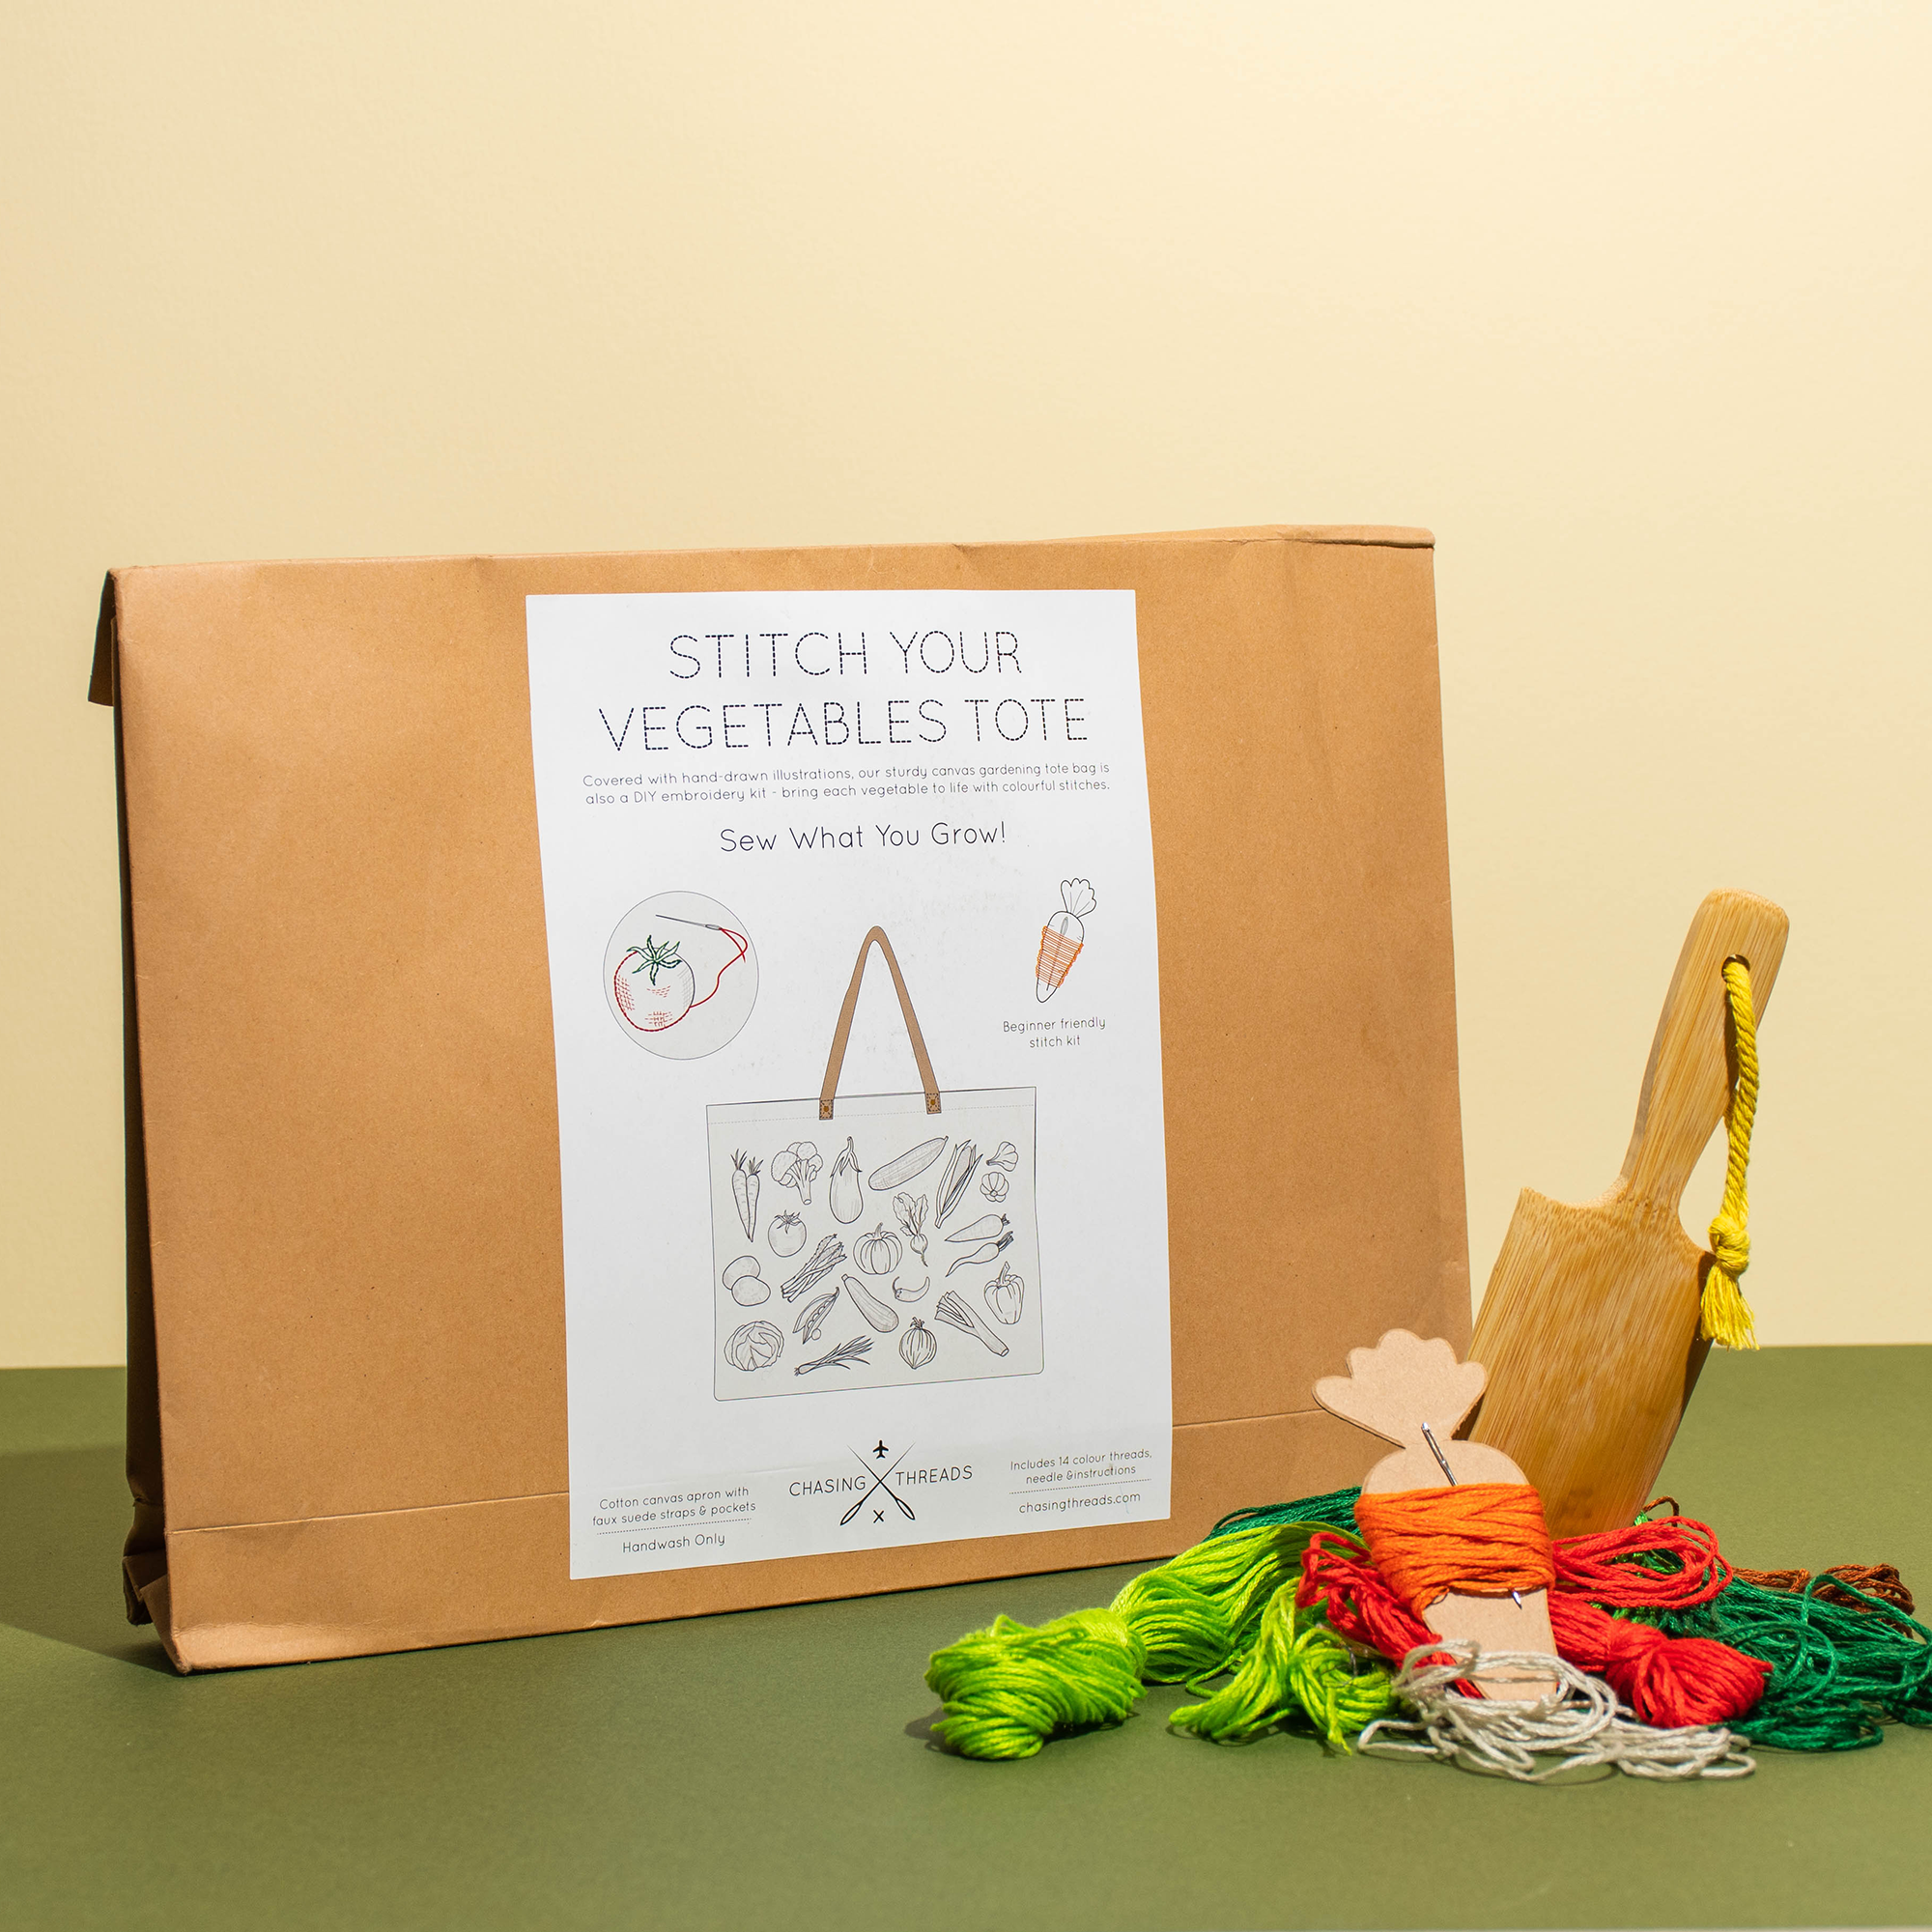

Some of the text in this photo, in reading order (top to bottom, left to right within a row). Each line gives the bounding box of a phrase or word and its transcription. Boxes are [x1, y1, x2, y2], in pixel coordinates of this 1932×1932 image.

[669, 630, 1023, 680] STITCH YOUR
[598, 697, 1088, 753] VEGETABLES TOTE
[582, 762, 1110, 787] Covered with hand-drawn illustrations, our sturdy canvas gardening tote bag is
[585, 792, 615, 805] also
[619, 794, 629, 804] a
[633, 790, 657, 804] DIY
[661, 788, 745, 803] embroidery
[750, 786, 766, 799] kit
[781, 786, 818, 801] bring
[823, 784, 857, 797] each
[860, 782, 929, 799] vegetable
[932, 781, 946, 794] to
[950, 781, 969, 794] life
[972, 781, 999, 793] with
[1002, 780, 1056, 793] colourful
[1059, 779, 1110, 791] stitches.
[720, 820, 1006, 853] Sew What You Grow!
[1003, 1016, 1106, 1035] Beginner friendly
[1029, 1034, 1081, 1049] stitch kit
[1009, 1448, 1152, 1471] Includes 14 colour threads,
[789, 1465, 973, 1496] CHASING THREADS
[1025, 1471, 1064, 1485] needle
[599, 1486, 750, 1511] Cotton canvas apron with
[1018, 1492, 1141, 1514] chasingthreads.com
[592, 1500, 756, 1526] faux suede straps & pockets
[622, 1532, 725, 1553] Handwash Only
